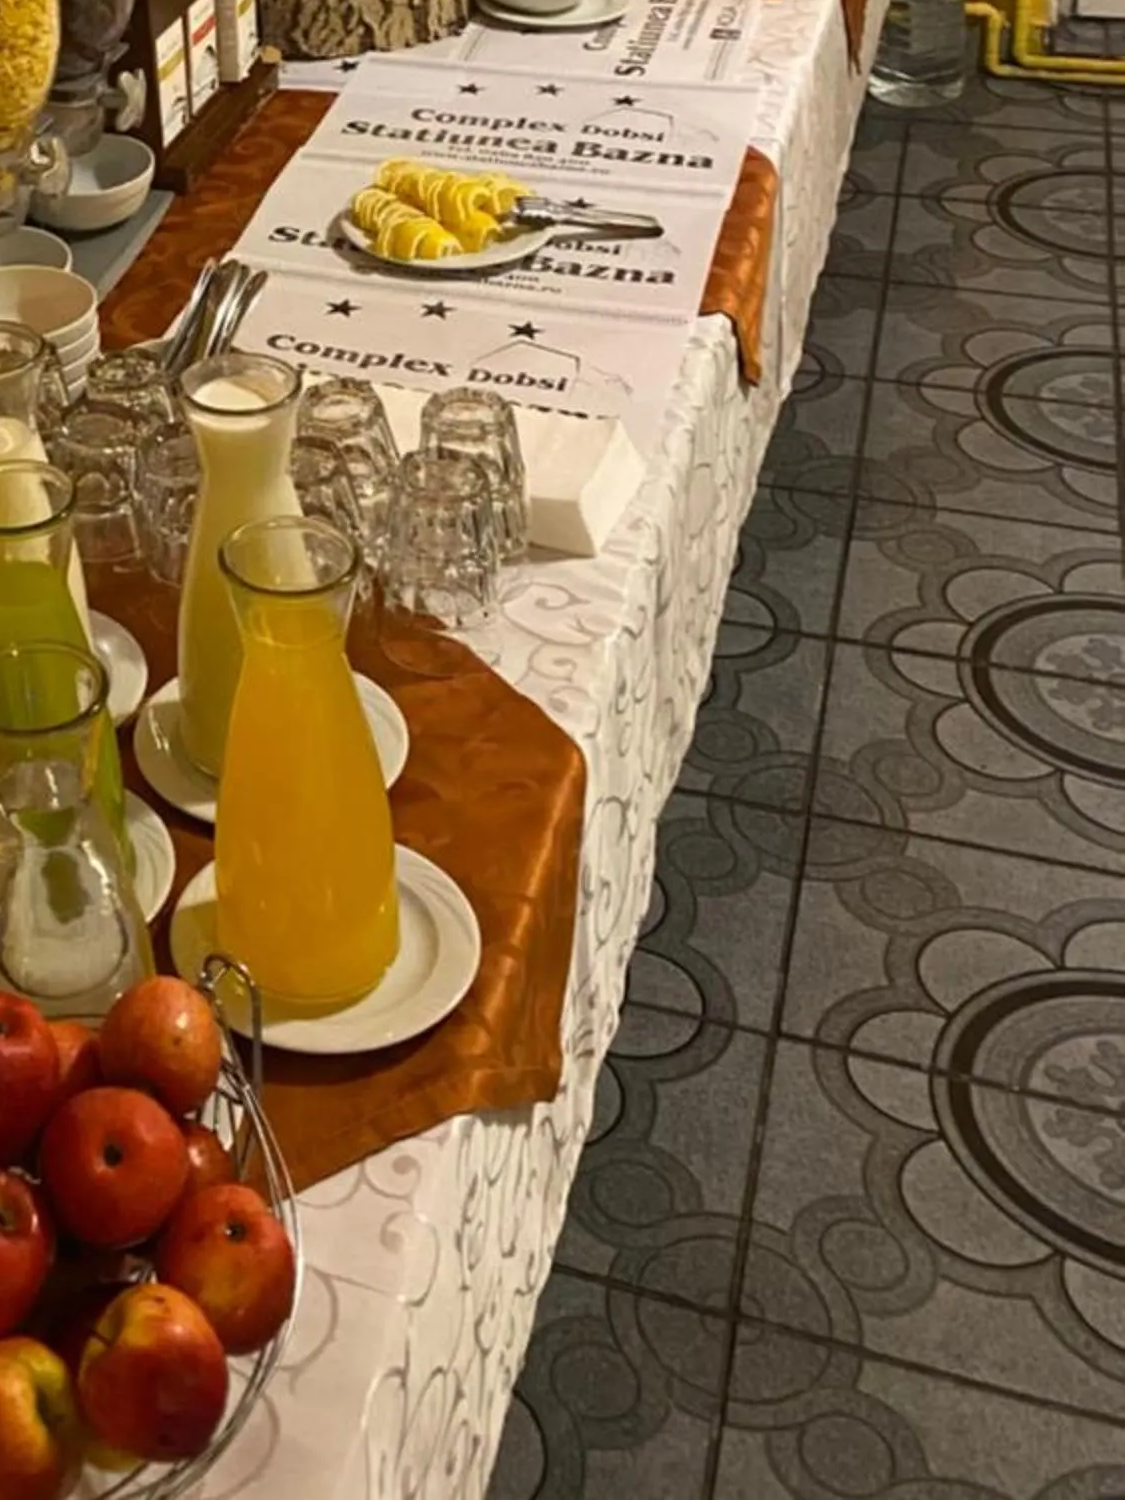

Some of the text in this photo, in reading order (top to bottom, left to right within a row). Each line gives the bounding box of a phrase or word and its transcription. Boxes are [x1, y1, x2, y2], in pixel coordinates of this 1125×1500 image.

[613, 6, 674, 77] Statiunea
[340, 119, 715, 171] Statiunea Bazna
[410, 107, 666, 143] Complex Dobsi
[519, 253, 676, 285] Bazna
[266, 333, 454, 378] Complex
[467, 368, 569, 393] Dobsi
